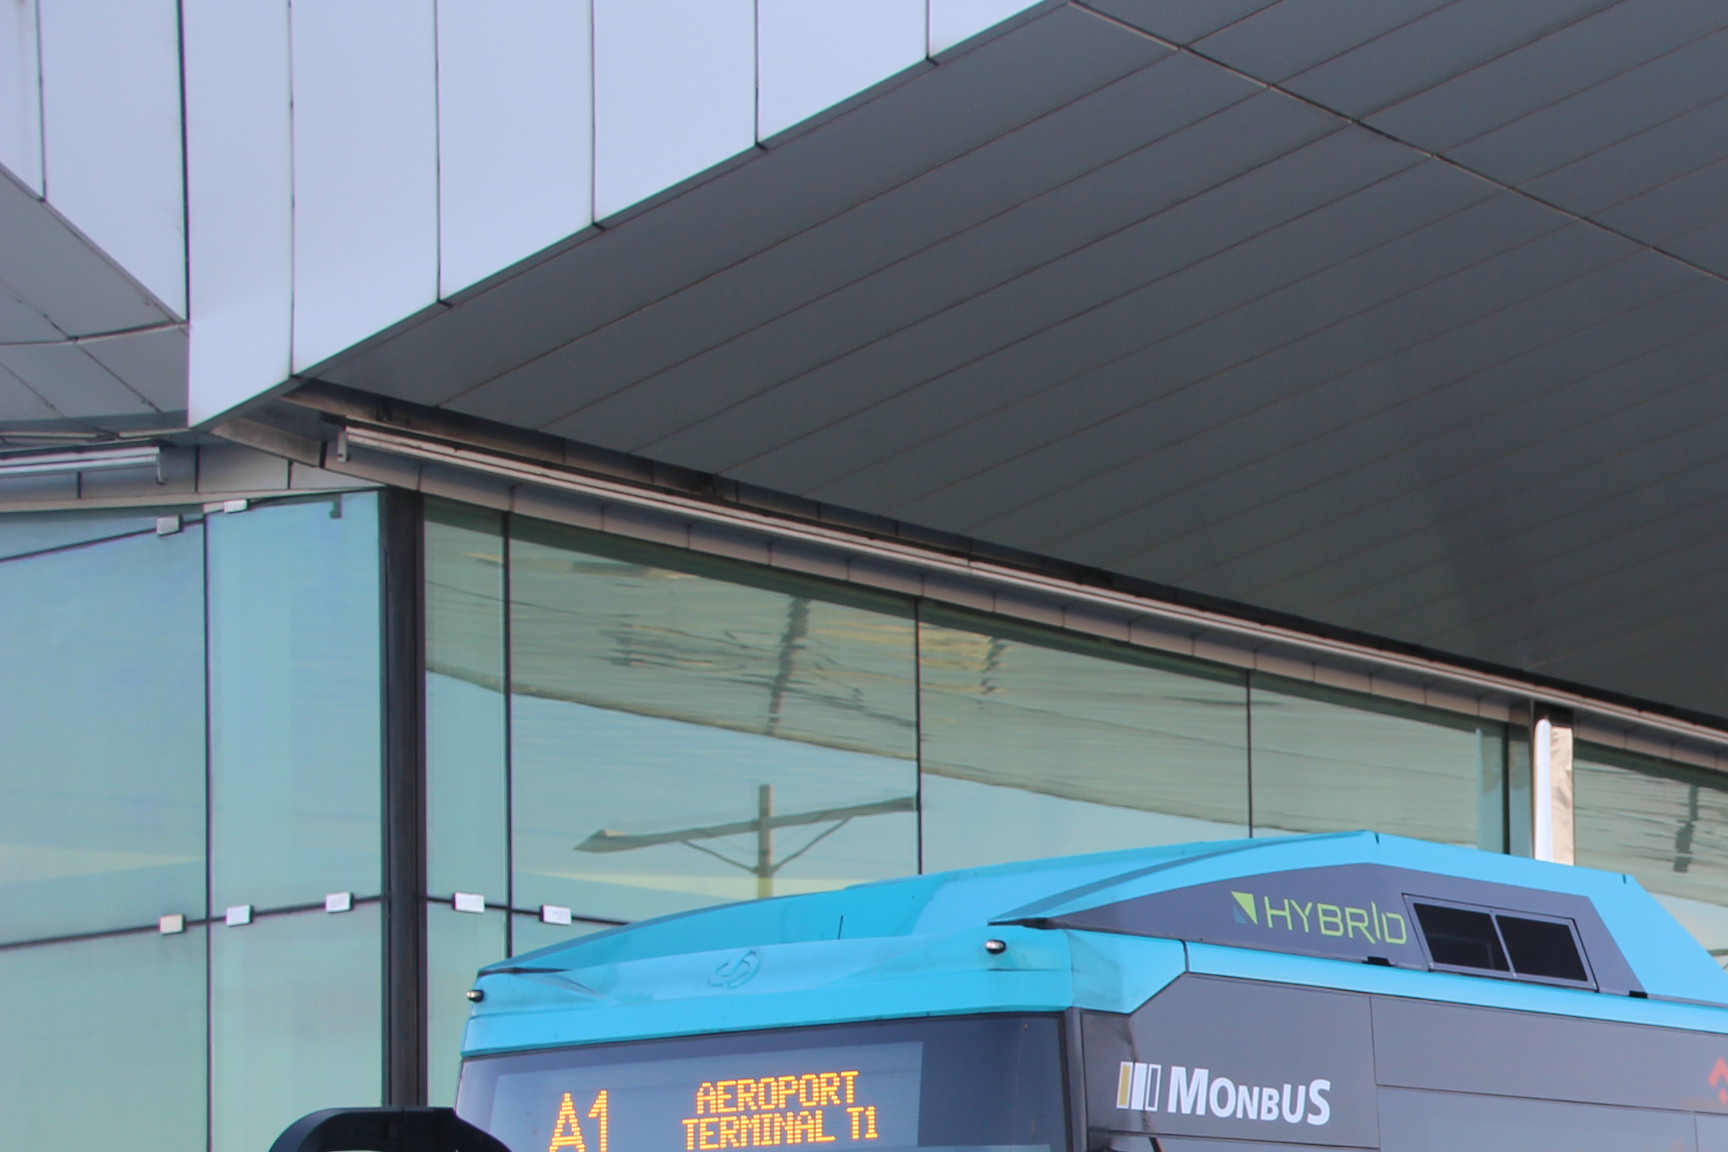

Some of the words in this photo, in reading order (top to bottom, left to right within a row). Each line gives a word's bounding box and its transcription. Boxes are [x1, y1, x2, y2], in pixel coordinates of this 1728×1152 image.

[1263, 895, 1408, 945] HYBRID
[696, 1070, 860, 1115] AEROPORT
[1167, 1065, 1331, 1126] MONBUS
[682, 1109, 836, 1151] TERMINAL
[847, 1105, 879, 1140] T1
